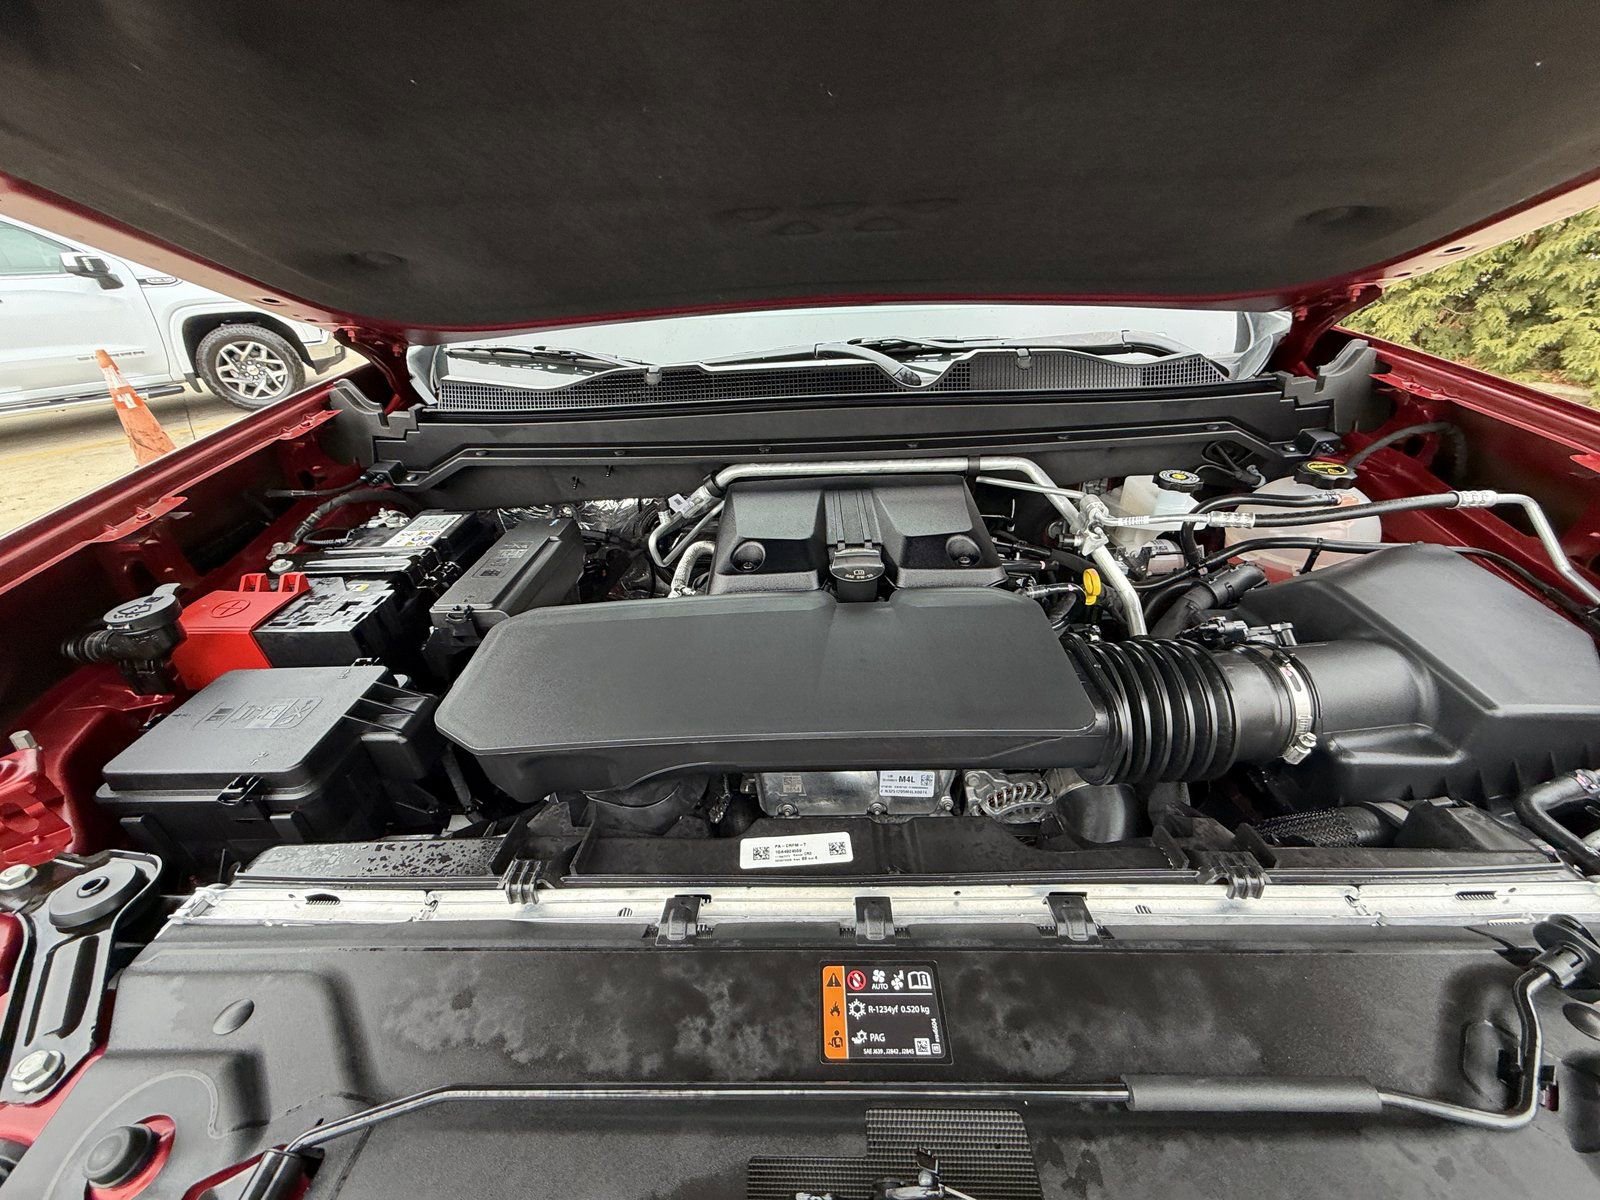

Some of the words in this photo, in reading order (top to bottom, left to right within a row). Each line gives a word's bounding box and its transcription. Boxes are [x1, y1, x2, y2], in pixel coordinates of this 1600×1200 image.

[898, 775, 916, 784] M4L
[867, 1005, 899, 1015] R-1234yf
[900, 1005, 920, 1014] 0.520
[921, 1005, 930, 1015] kg
[869, 1033, 886, 1042] PAG
